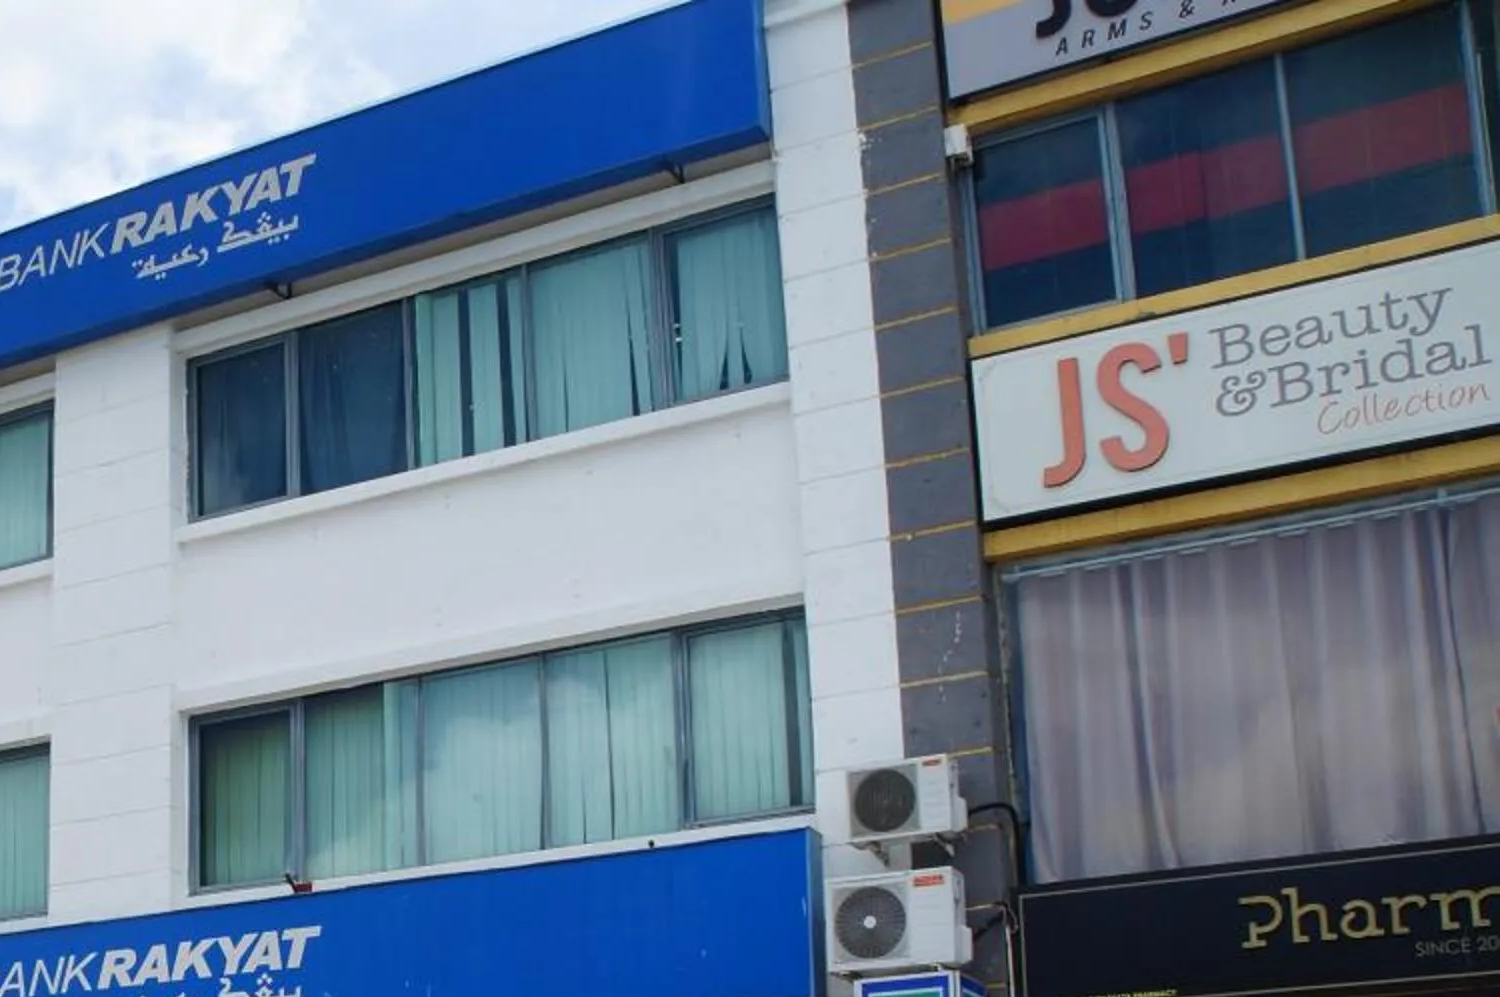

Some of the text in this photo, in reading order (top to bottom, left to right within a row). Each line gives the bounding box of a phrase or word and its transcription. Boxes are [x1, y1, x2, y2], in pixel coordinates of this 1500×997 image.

[1055, 12, 1153, 56] ARMS
[1207, 287, 1453, 369] Beauty
[1043, 332, 1189, 489] JS'
[1316, 382, 1491, 435] Collection
[1414, 936, 1472, 958] SINCE
